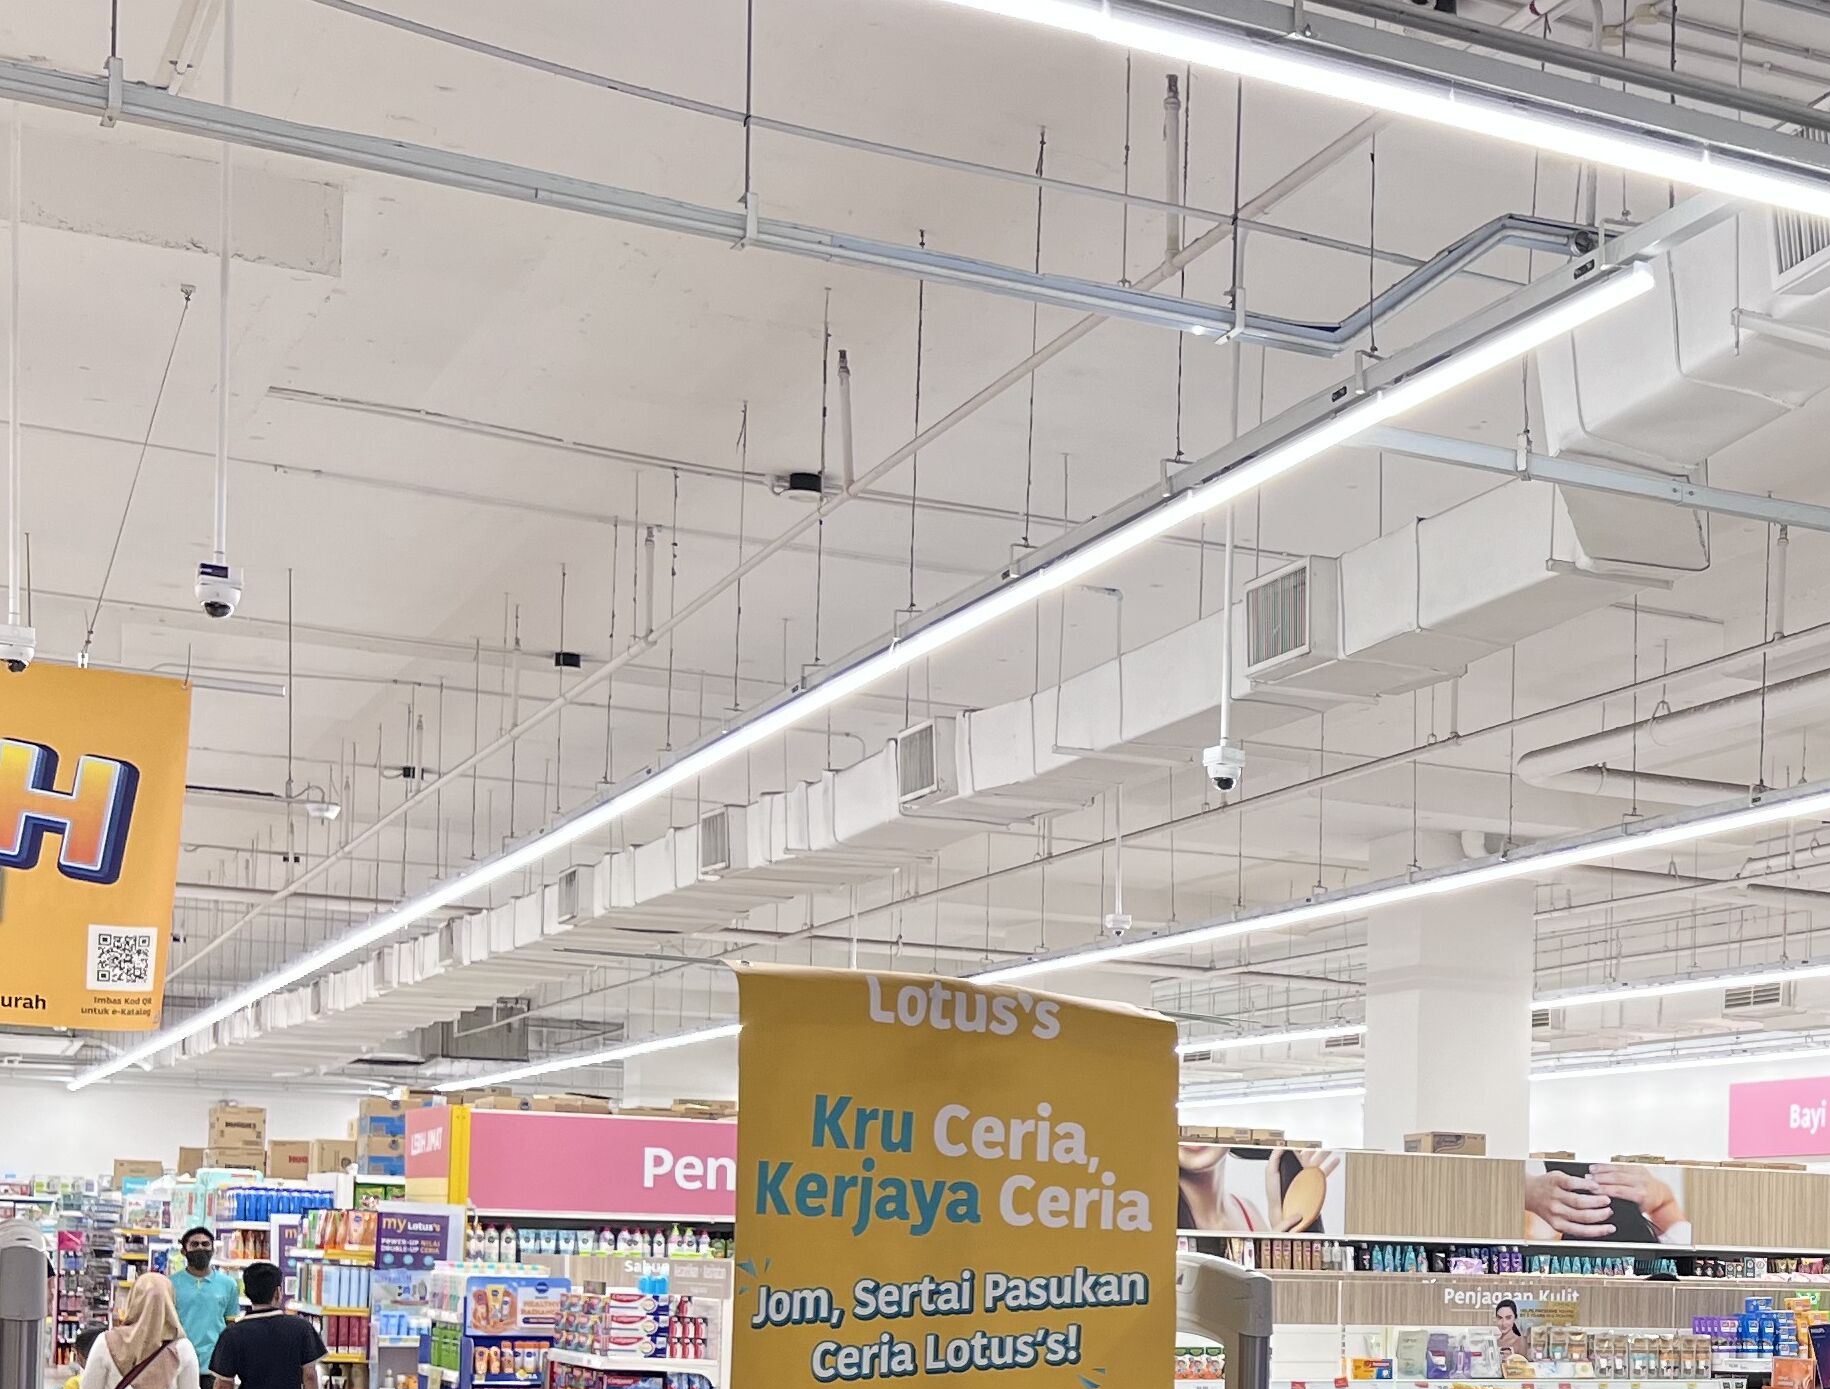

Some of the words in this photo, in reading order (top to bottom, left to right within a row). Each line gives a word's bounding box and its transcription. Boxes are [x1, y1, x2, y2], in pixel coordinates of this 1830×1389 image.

[81, 1007, 109, 1015] untuk
[112, 1008, 152, 1018] e-Katalog
[93, 996, 122, 1005] Imbas
[124, 996, 140, 1005] Kod
[867, 975, 1062, 1040] Lotus's
[811, 1094, 914, 1153] Kru
[933, 1102, 1099, 1174] Ceria,
[1788, 1102, 1827, 1133] Bayi
[755, 1157, 981, 1237] Kerjaya
[1000, 1171, 1153, 1232] Ceria
[382, 1216, 406, 1233] my
[751, 1284, 845, 1330] Jom,
[853, 1269, 975, 1320] Sertai
[983, 1266, 1149, 1313] Pasukan
[1443, 1287, 1534, 1310] Penjagaan
[1538, 1289, 1580, 1303] Kulit
[811, 1331, 918, 1383] Ceria
[924, 1324, 1082, 1375] Lotus's!
